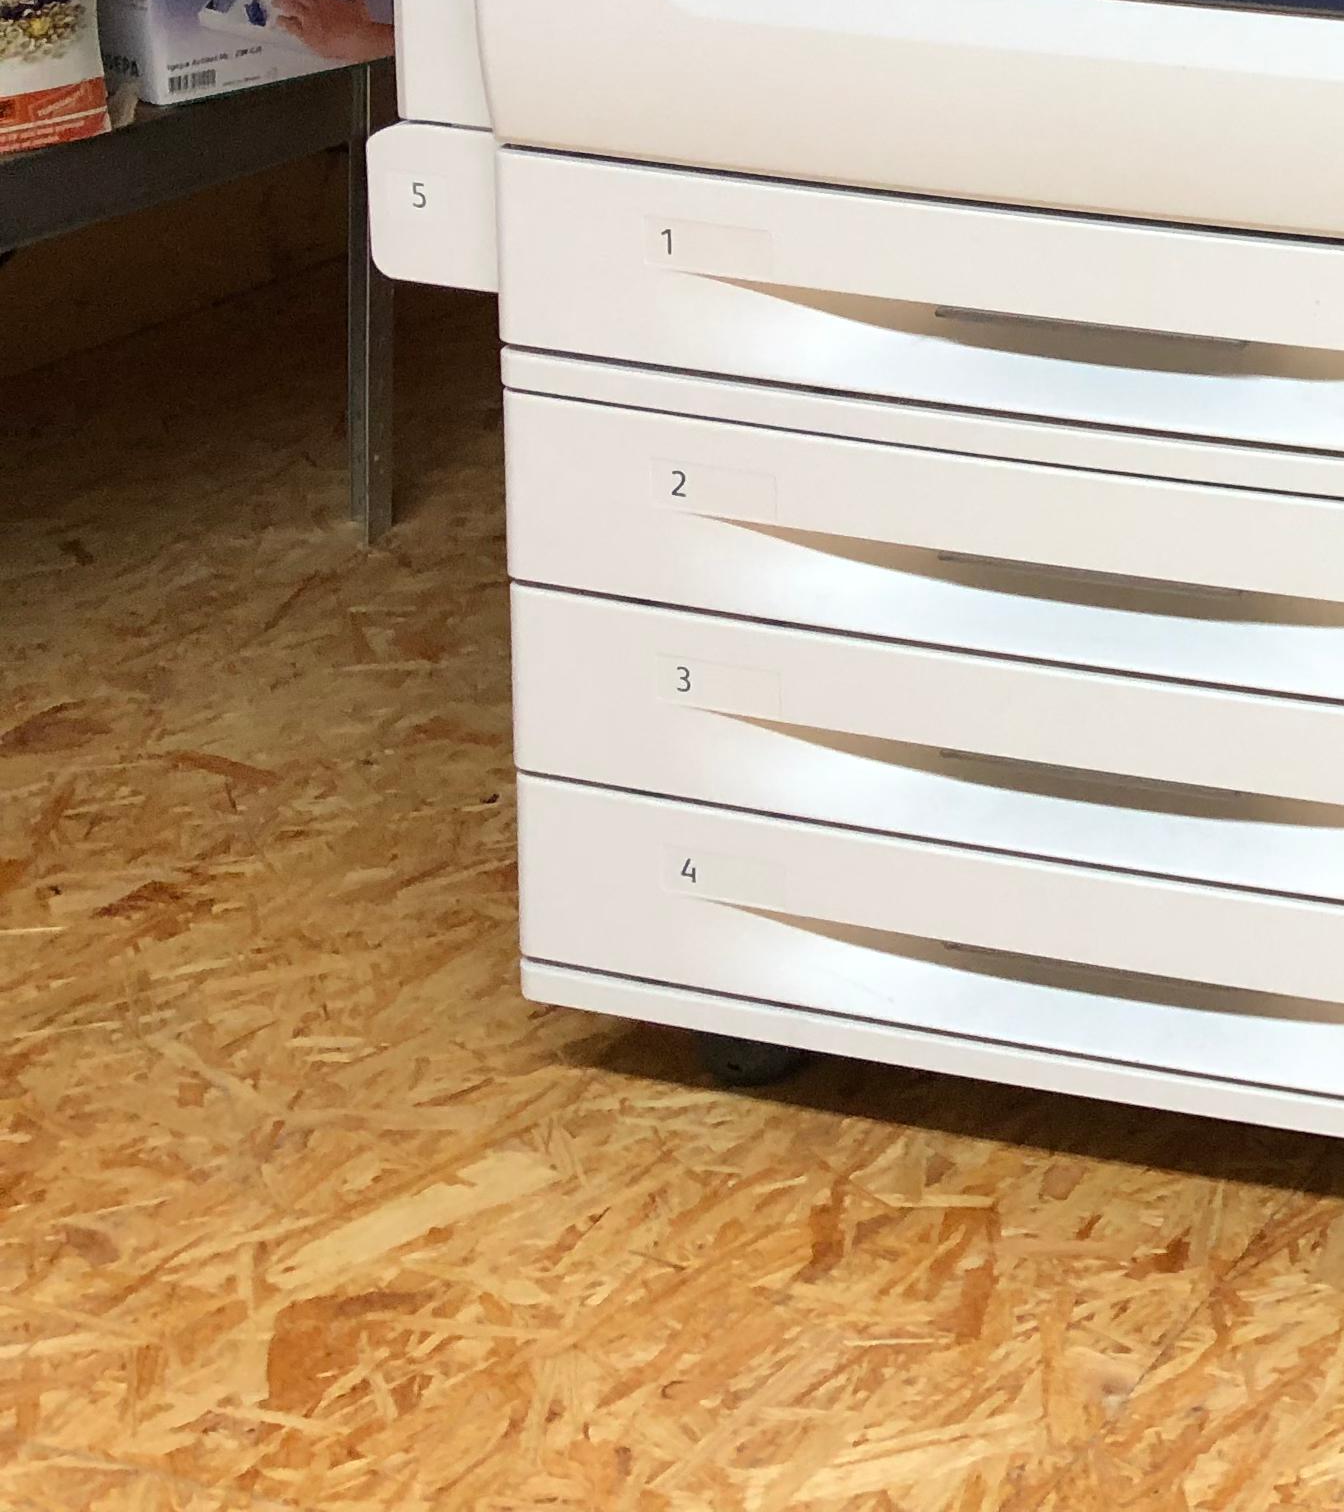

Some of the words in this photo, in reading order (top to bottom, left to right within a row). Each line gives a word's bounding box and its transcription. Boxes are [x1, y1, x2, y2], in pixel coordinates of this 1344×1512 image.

[412, 182, 427, 208] 5
[660, 228, 672, 255] 1
[671, 470, 687, 497] 2
[676, 666, 691, 692] 3
[681, 858, 697, 883] 4
